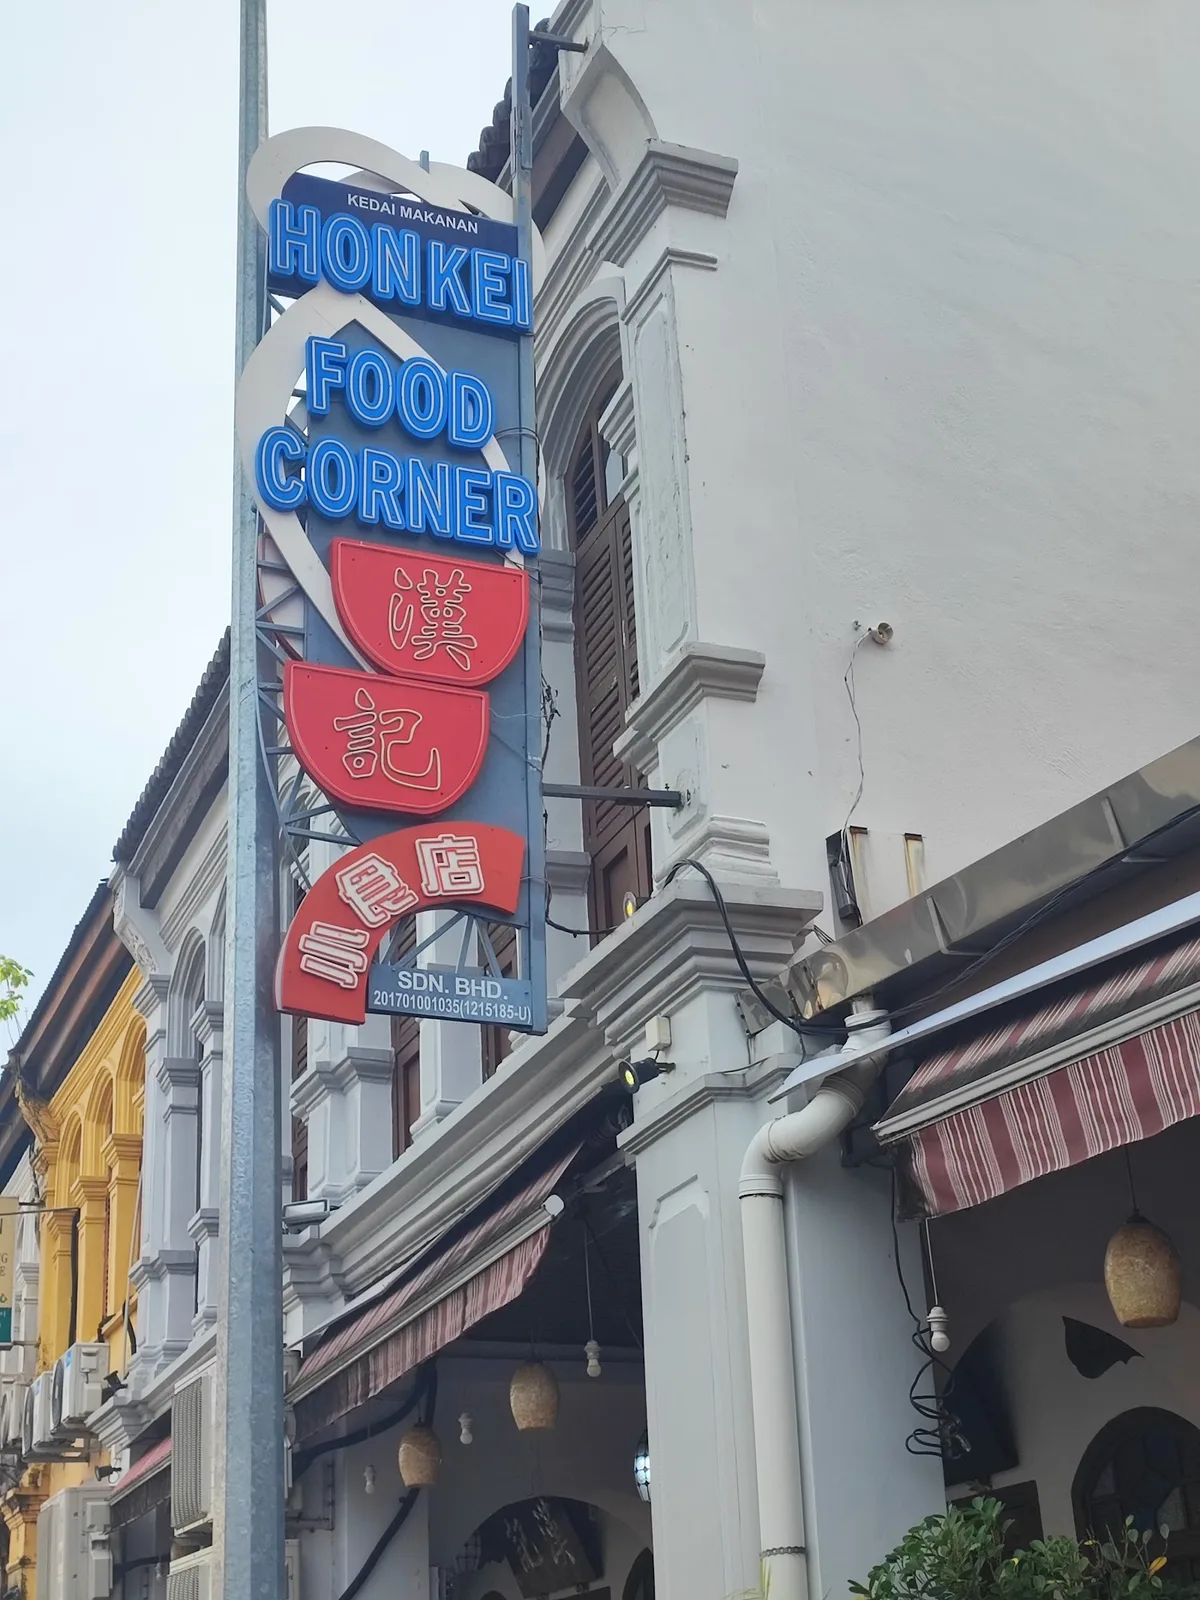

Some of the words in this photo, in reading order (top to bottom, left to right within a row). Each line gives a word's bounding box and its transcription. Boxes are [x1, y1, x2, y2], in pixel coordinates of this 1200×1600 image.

[347, 193, 396, 216] KEDAI
[400, 205, 479, 234] MAKANAN
[305, 335, 494, 450] FOOD
[255, 425, 540, 557] CORNER
[397, 970, 450, 994] SDN.
[455, 977, 509, 1000] BHD.
[373, 989, 532, 1024] 201701001035(1215185-U)
